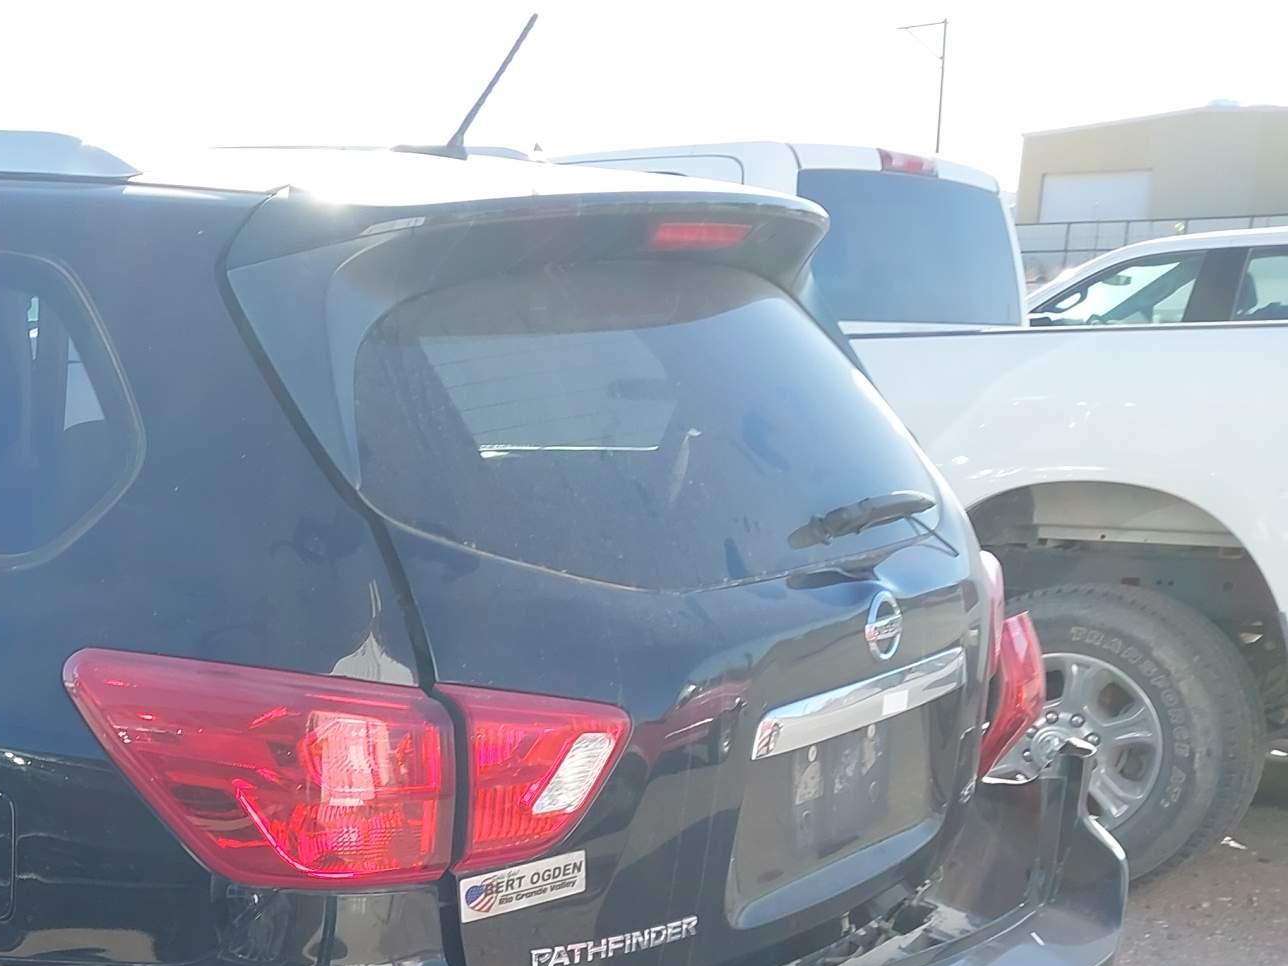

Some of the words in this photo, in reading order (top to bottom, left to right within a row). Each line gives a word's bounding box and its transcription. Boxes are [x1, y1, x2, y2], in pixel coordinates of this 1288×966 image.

[484, 875, 526, 896] BERT
[529, 860, 584, 885] OGDEN
[515, 887, 548, 901] Grande
[549, 879, 578, 892] Valley
